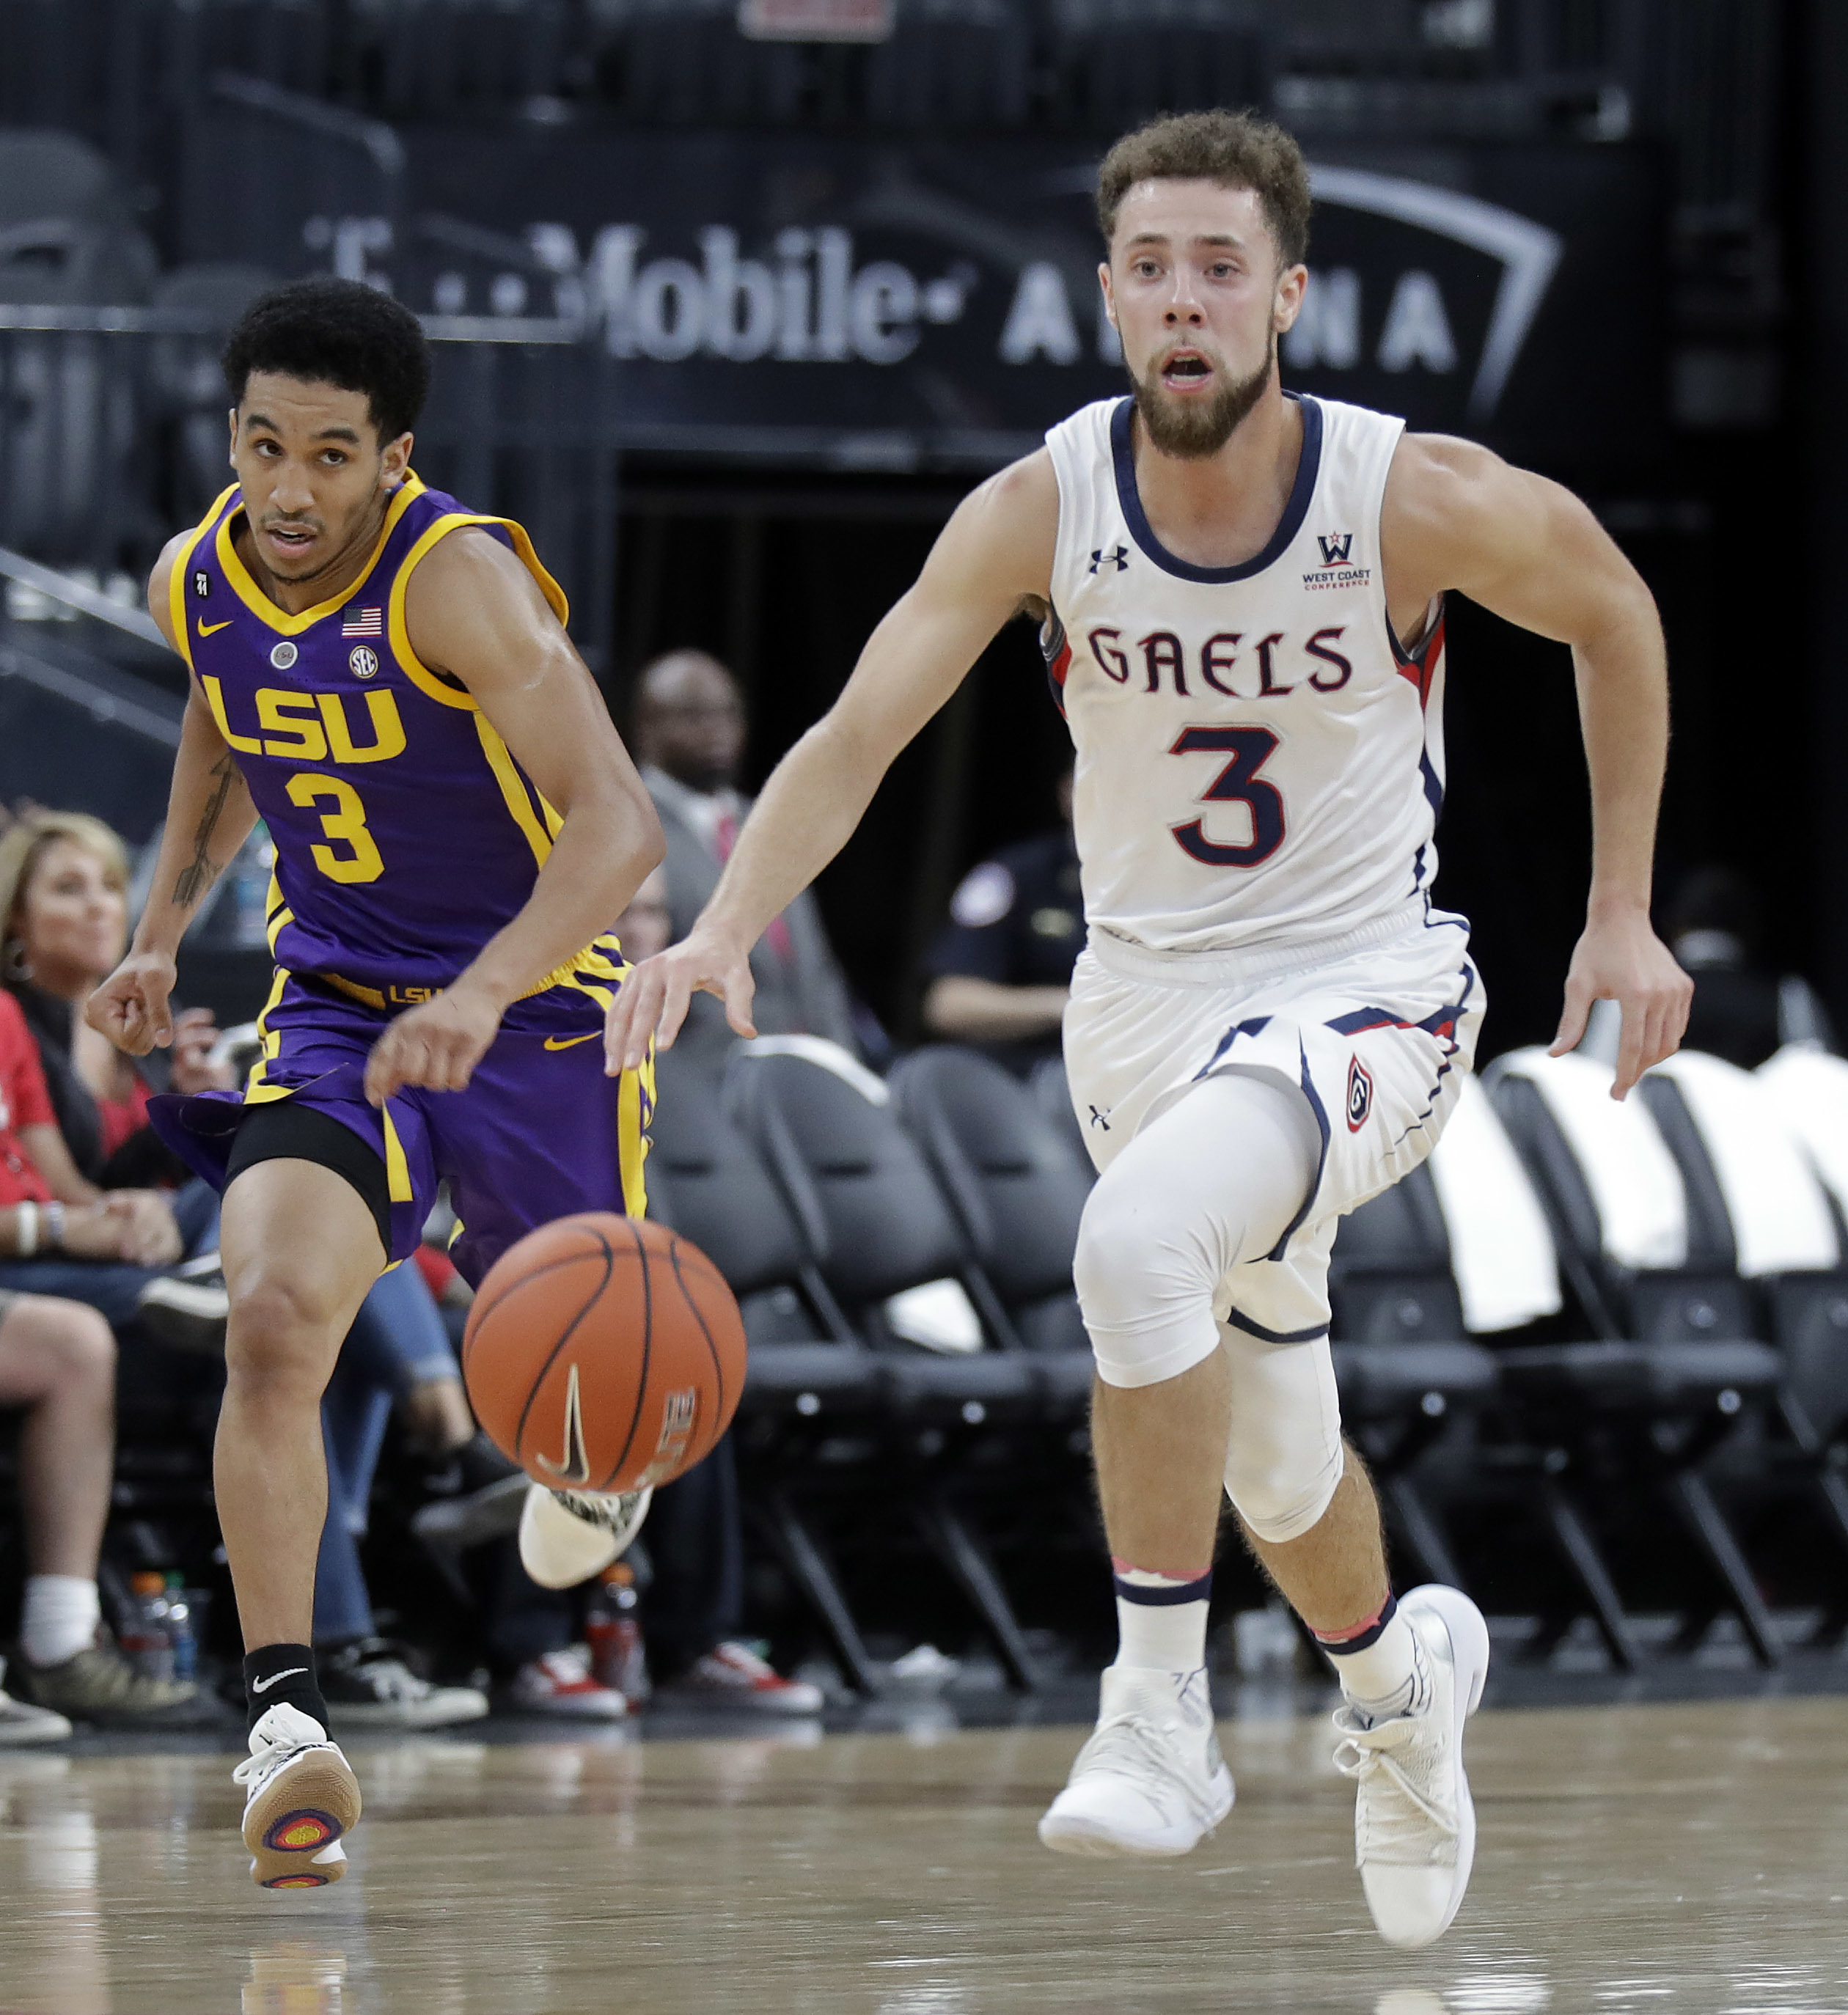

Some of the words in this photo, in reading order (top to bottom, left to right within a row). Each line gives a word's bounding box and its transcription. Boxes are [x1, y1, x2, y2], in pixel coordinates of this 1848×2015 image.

[998, 262, 1461, 373] ANA
[1302, 573, 1335, 583] WEST
[1338, 570, 1371, 581] COAST
[1304, 579, 1370, 591] CONFERENCE
[352, 648, 375, 675] SEC
[1088, 628, 1353, 697] GAELS
[202, 675, 407, 764] LSU
[285, 773, 386, 884] 3
[1167, 724, 1287, 868] 3
